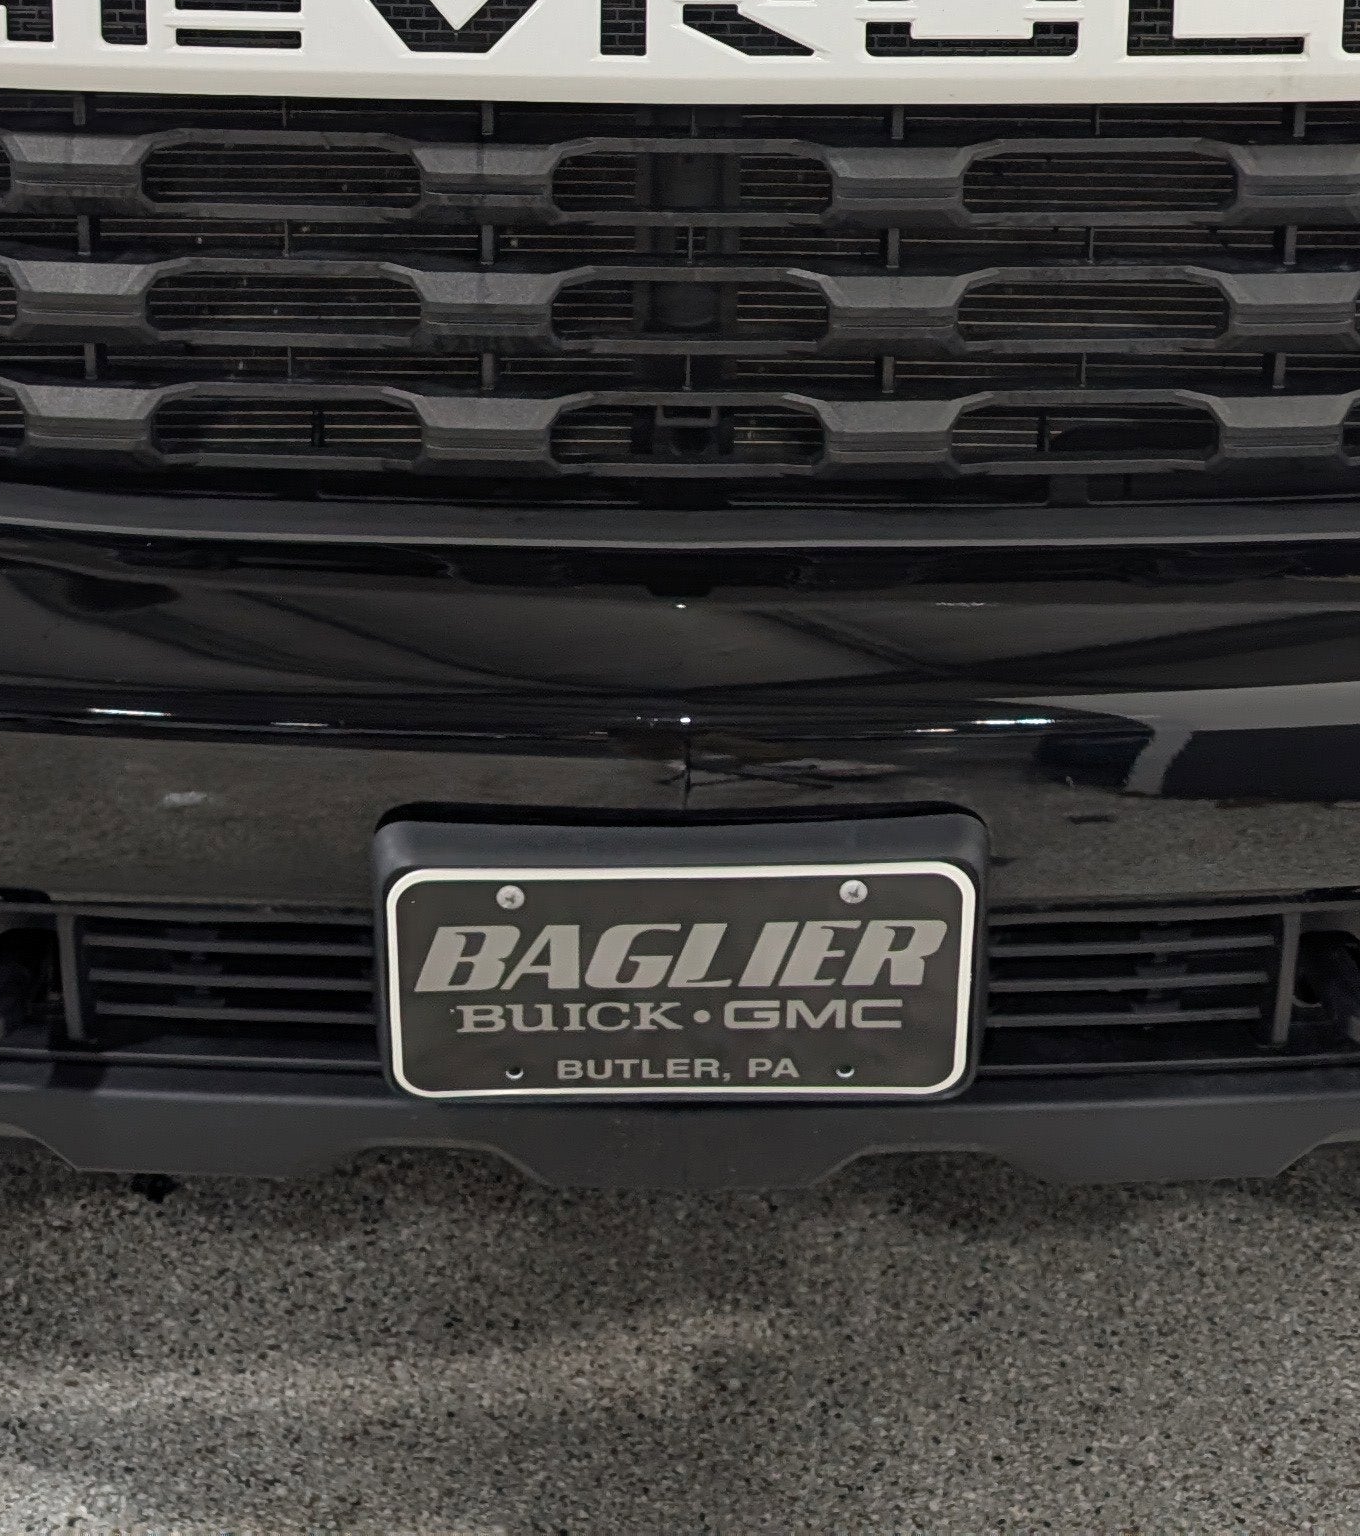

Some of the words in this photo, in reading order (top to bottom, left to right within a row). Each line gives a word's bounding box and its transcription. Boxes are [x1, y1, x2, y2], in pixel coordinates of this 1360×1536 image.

[414, 919, 948, 992] BAGLIER
[456, 1001, 683, 1033] BUICK
[723, 999, 903, 1029] GMC
[556, 1058, 731, 1082] BUTLER,
[748, 1057, 800, 1079] PA
